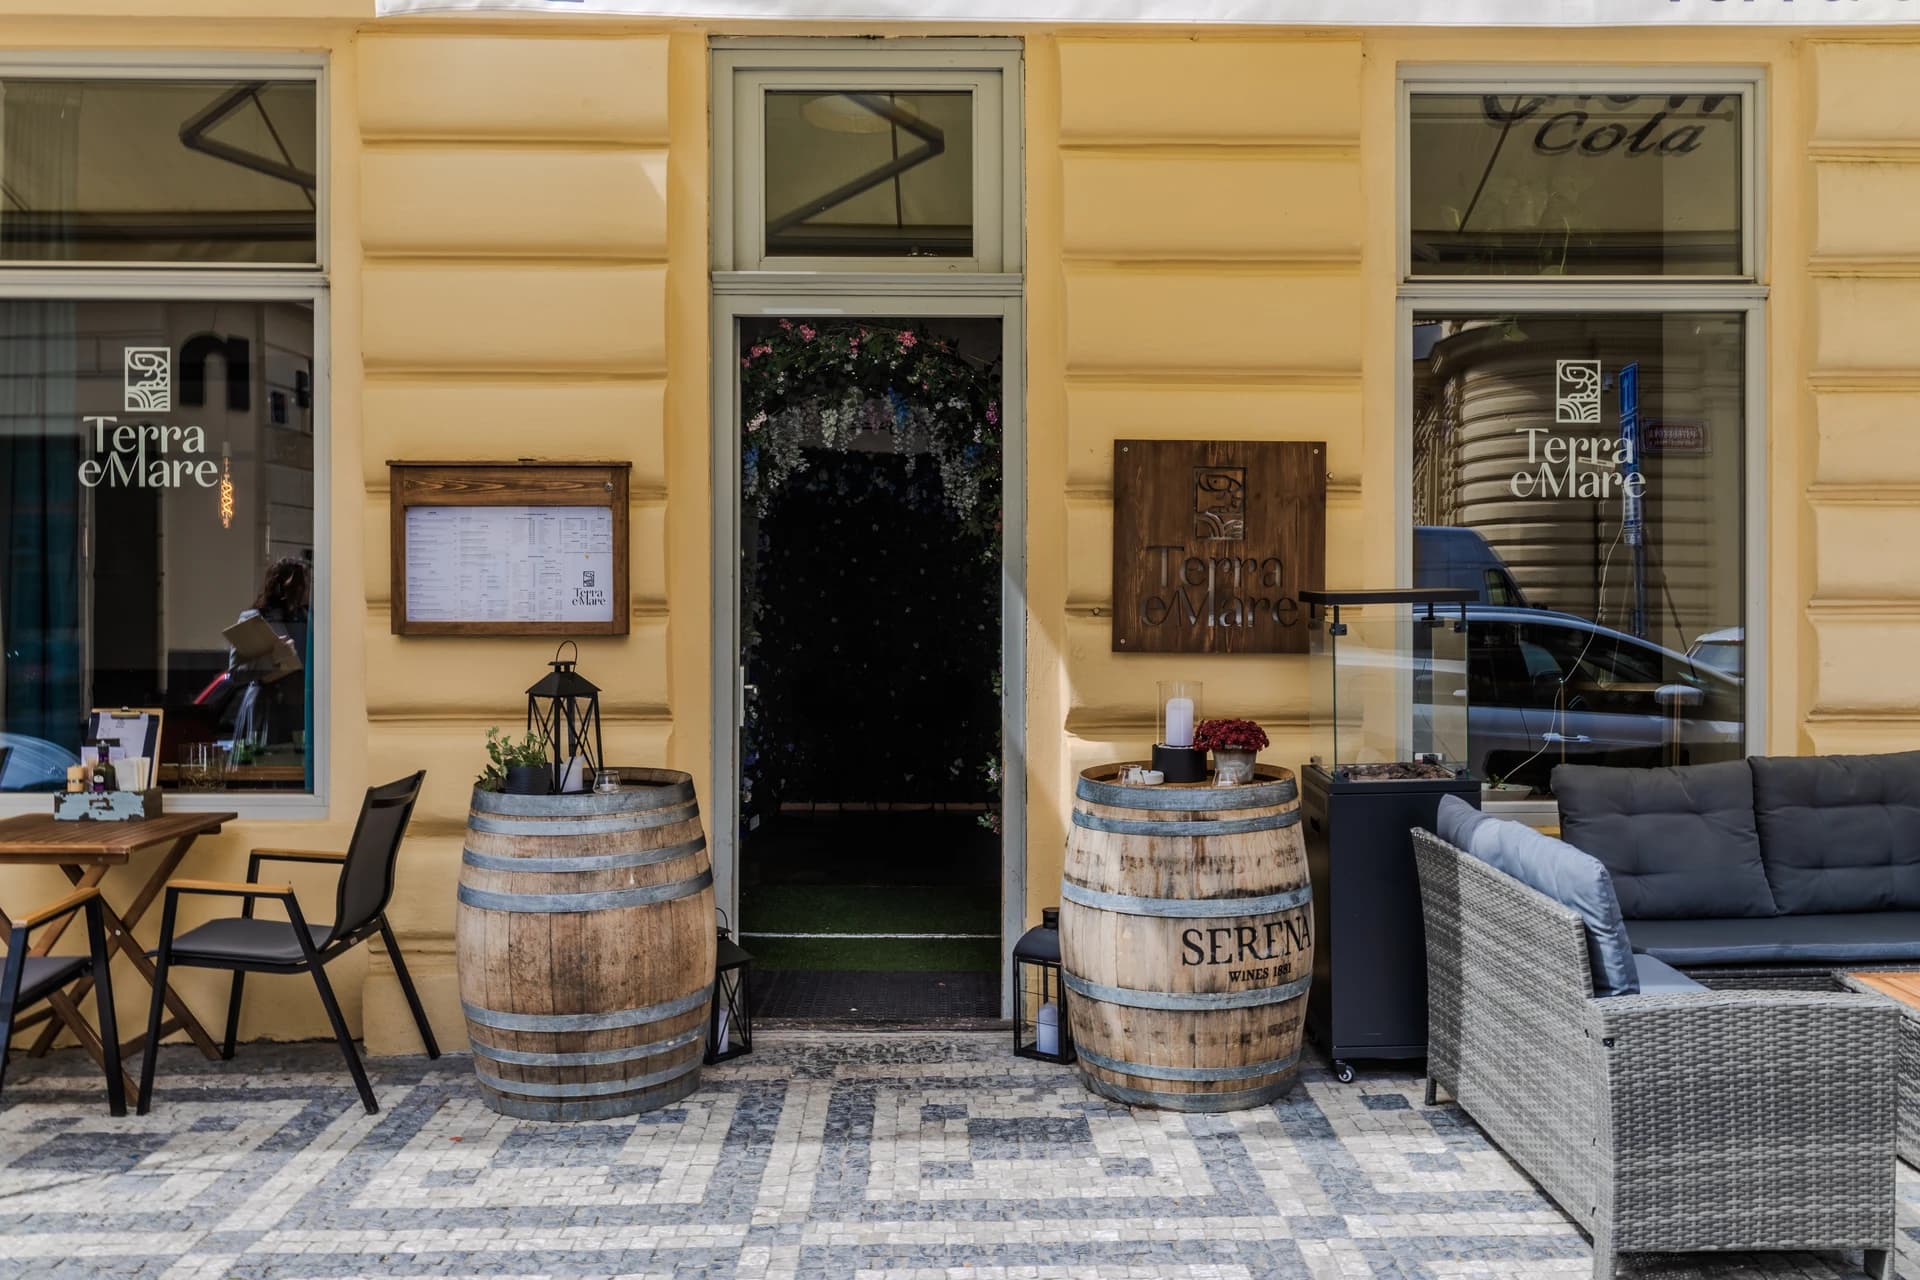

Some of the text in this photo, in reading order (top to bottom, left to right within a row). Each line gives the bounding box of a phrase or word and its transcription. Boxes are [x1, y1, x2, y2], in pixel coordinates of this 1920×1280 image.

[1533, 111, 1706, 155] Cola
[82, 416, 205, 453] Terra
[1515, 428, 1634, 465] Terra
[1146, 545, 1284, 588] Terra
[572, 587, 604, 598] Terra
[1182, 915, 1312, 966] SERENA
[1229, 967, 1269, 983] WINES
